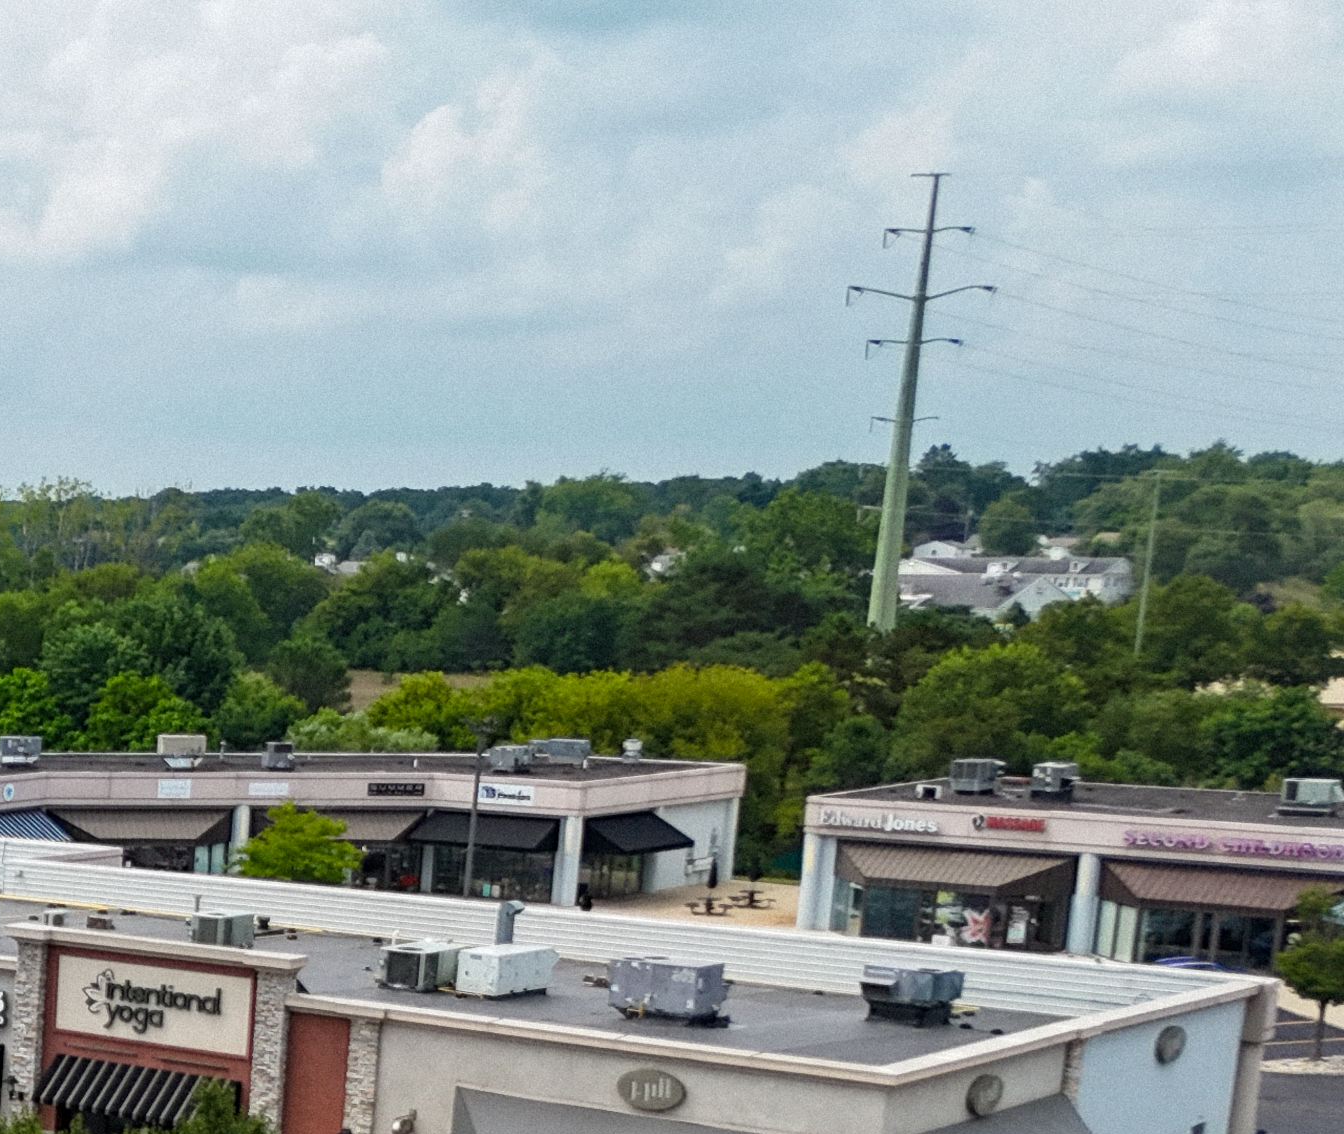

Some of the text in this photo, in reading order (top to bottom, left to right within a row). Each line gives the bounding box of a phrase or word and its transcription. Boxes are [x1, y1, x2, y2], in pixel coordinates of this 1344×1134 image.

[820, 808, 938, 833] Edward Jones
[1123, 830, 1211, 850] SECOND
[104, 978, 222, 1015] intentional
[103, 1003, 164, 1034] yoga
